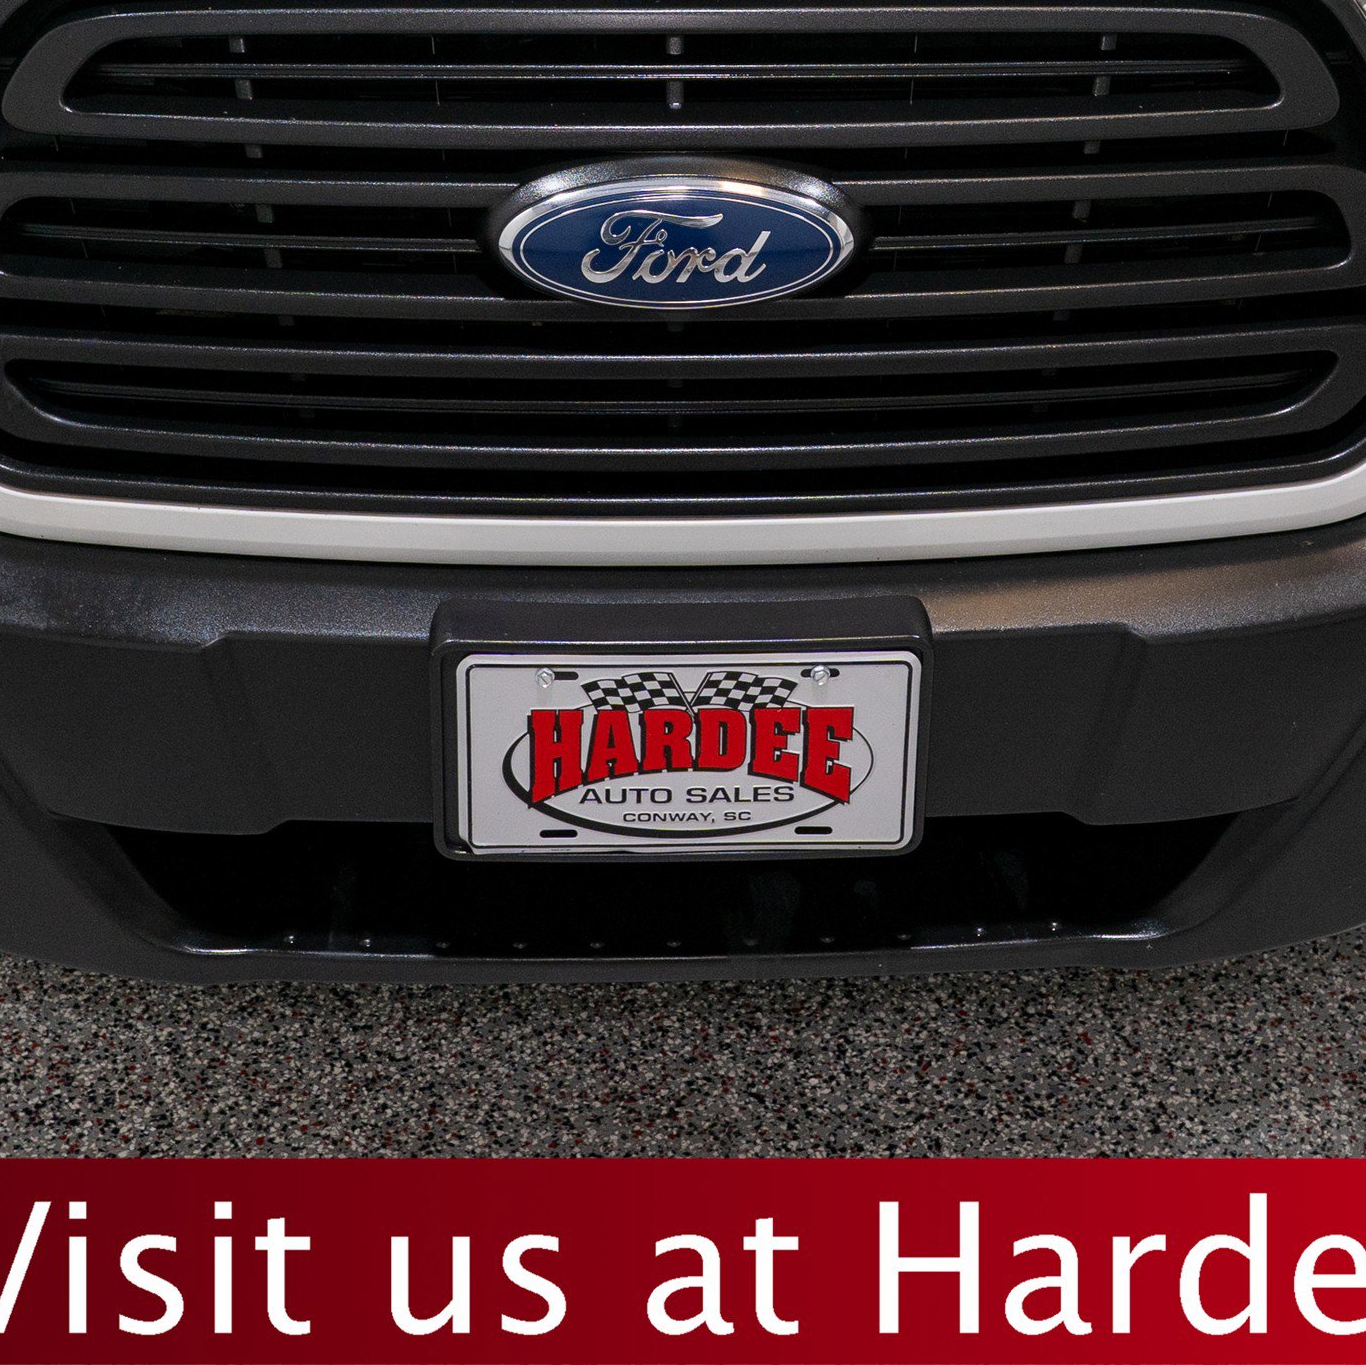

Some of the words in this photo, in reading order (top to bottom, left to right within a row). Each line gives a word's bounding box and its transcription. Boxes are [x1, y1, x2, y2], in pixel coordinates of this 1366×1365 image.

[580, 209, 772, 284] Ford
[528, 706, 855, 806] HARDEE
[579, 787, 673, 805] AUTO
[685, 785, 795, 804] SALES
[622, 812, 716, 824] CONWAY,
[723, 811, 753, 822] SC
